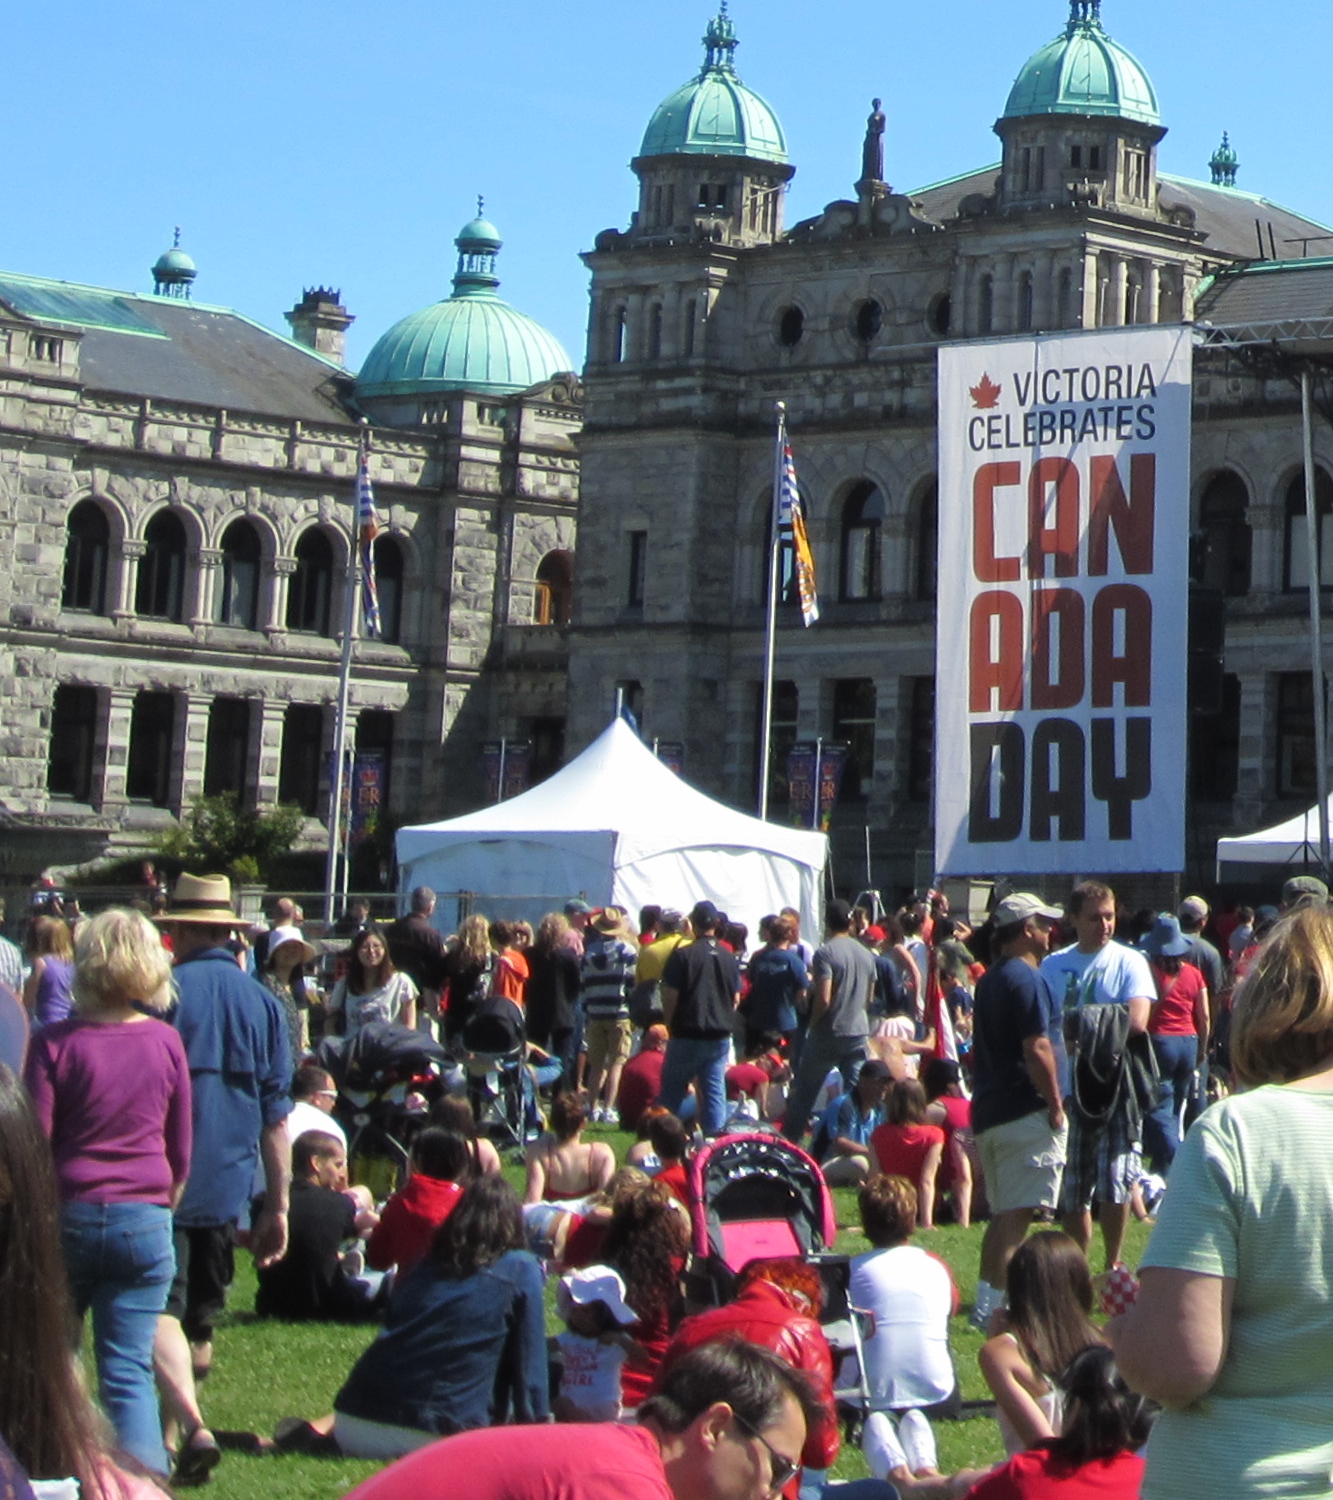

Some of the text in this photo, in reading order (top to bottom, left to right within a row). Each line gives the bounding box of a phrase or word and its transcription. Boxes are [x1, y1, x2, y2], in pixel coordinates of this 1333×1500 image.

[969, 404, 1156, 451] CELEBRATES
[1013, 363, 1157, 407] VICTORIA
[972, 453, 1156, 583] CAN
[969, 583, 1153, 713] ADA
[967, 717, 1152, 843] DAY
